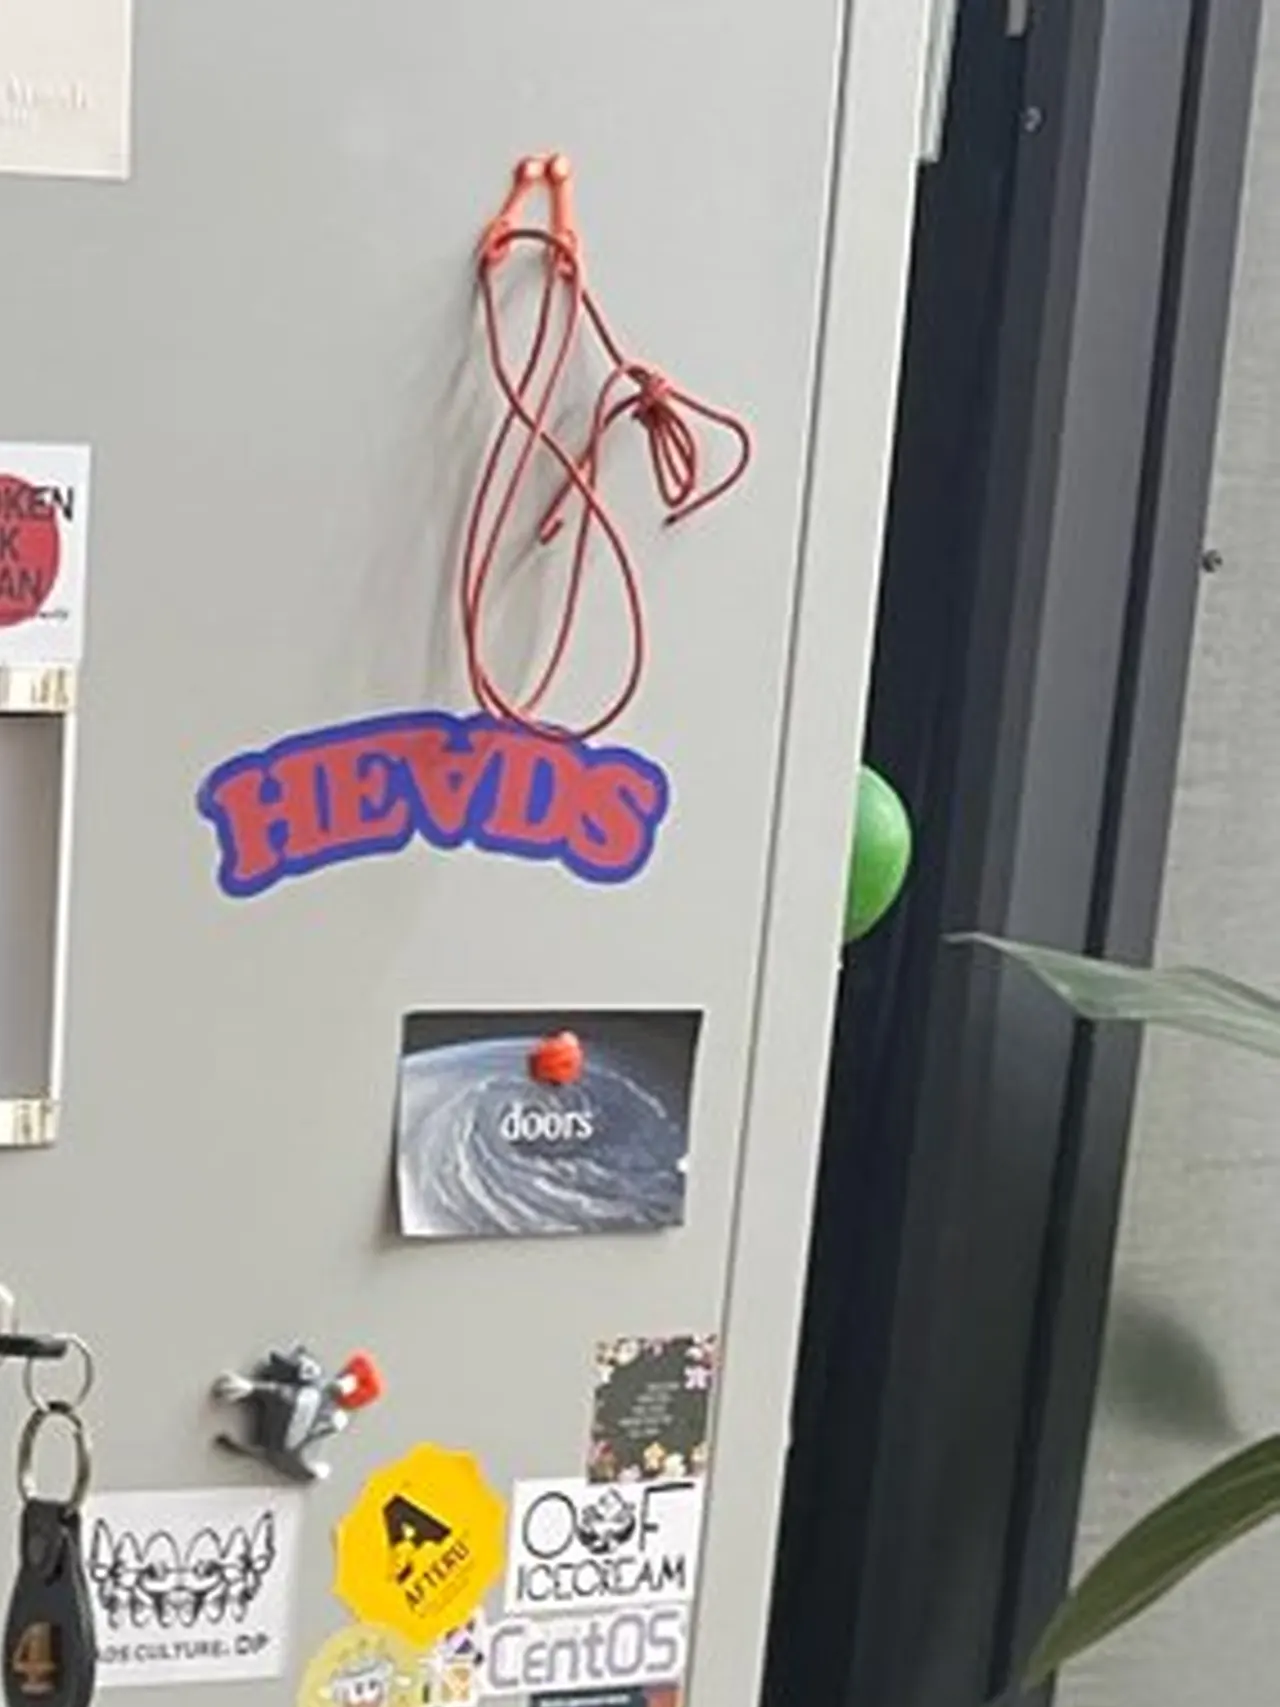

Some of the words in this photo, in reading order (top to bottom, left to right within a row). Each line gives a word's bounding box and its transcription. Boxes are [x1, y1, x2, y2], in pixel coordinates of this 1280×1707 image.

[500, 1103, 594, 1143] doors
[12, 1620, 57, 1694] 4
[489, 1610, 680, 1688] CentOS
